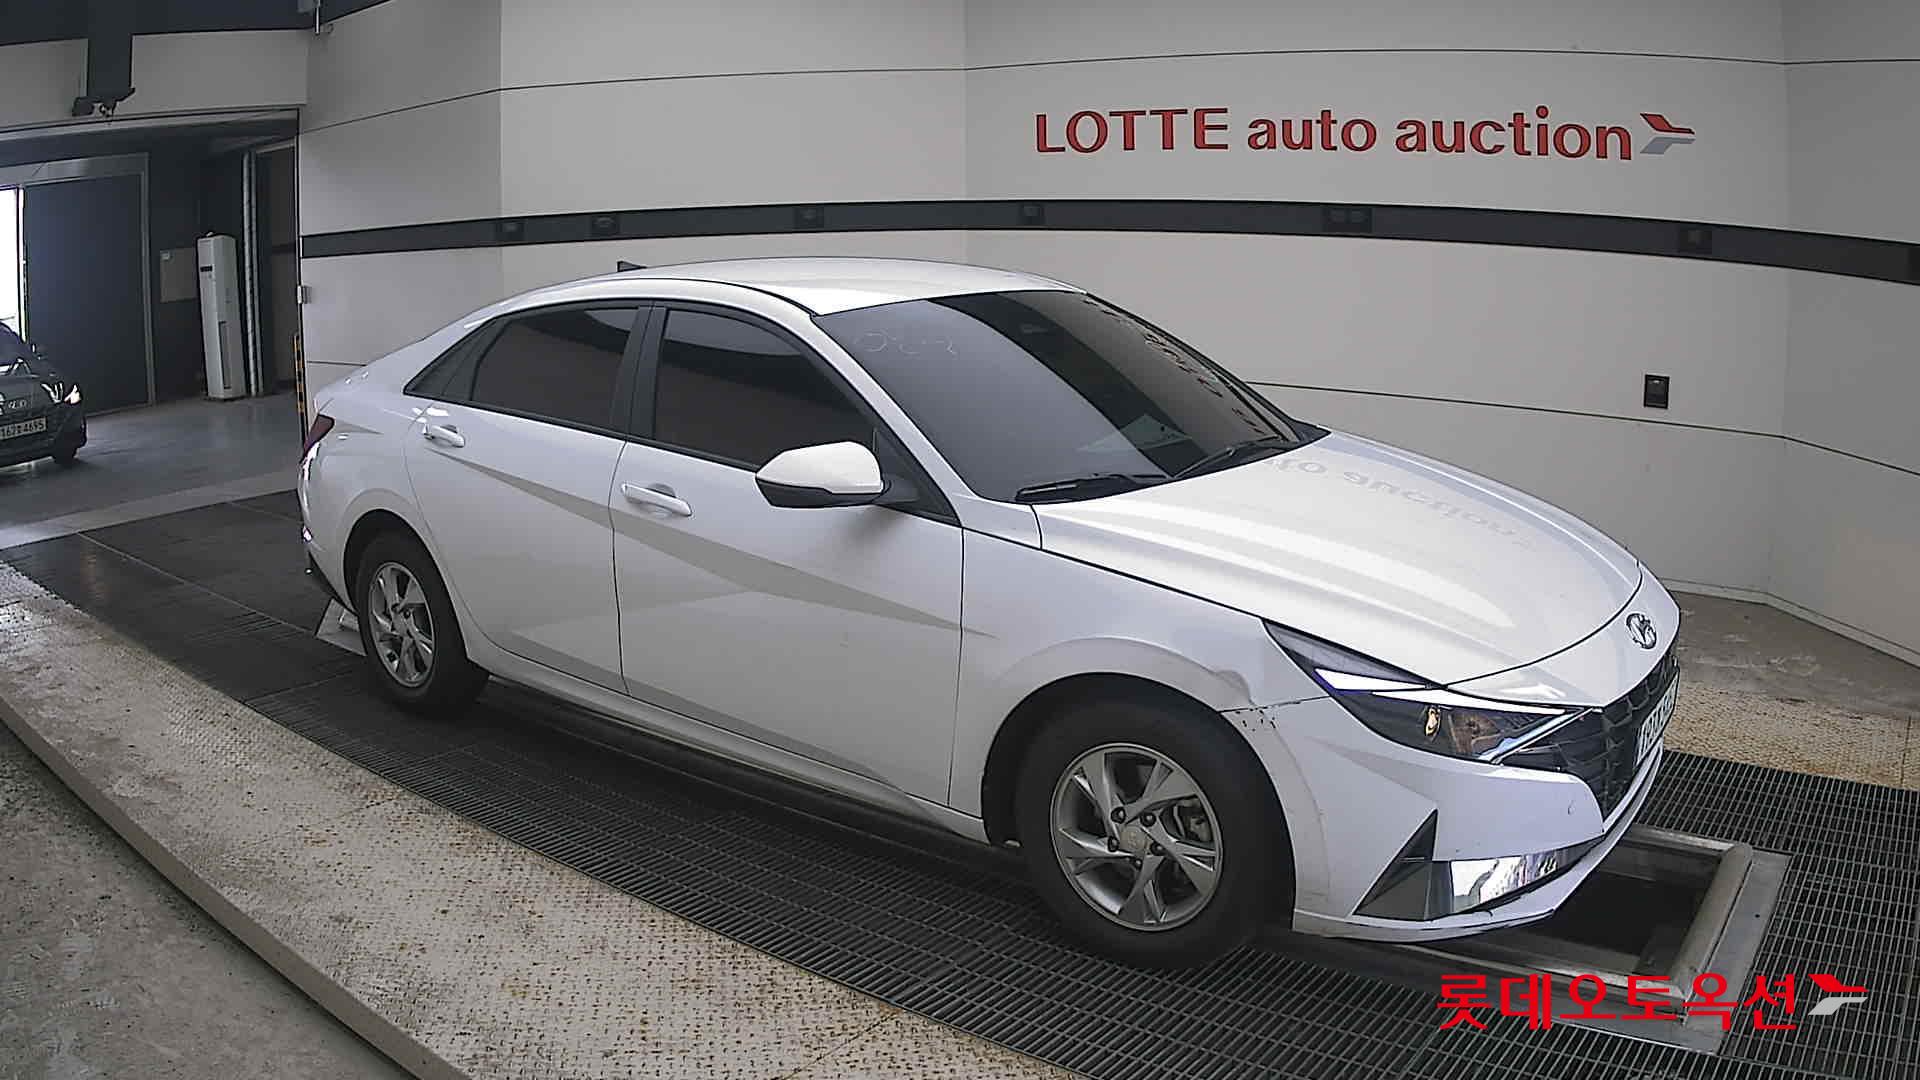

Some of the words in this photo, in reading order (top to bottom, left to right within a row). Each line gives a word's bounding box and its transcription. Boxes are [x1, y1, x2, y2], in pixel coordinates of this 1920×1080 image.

[1037, 108, 1229, 153] LOTTE
[1247, 110, 1377, 152] auto
[1395, 106, 1633, 160] auction
